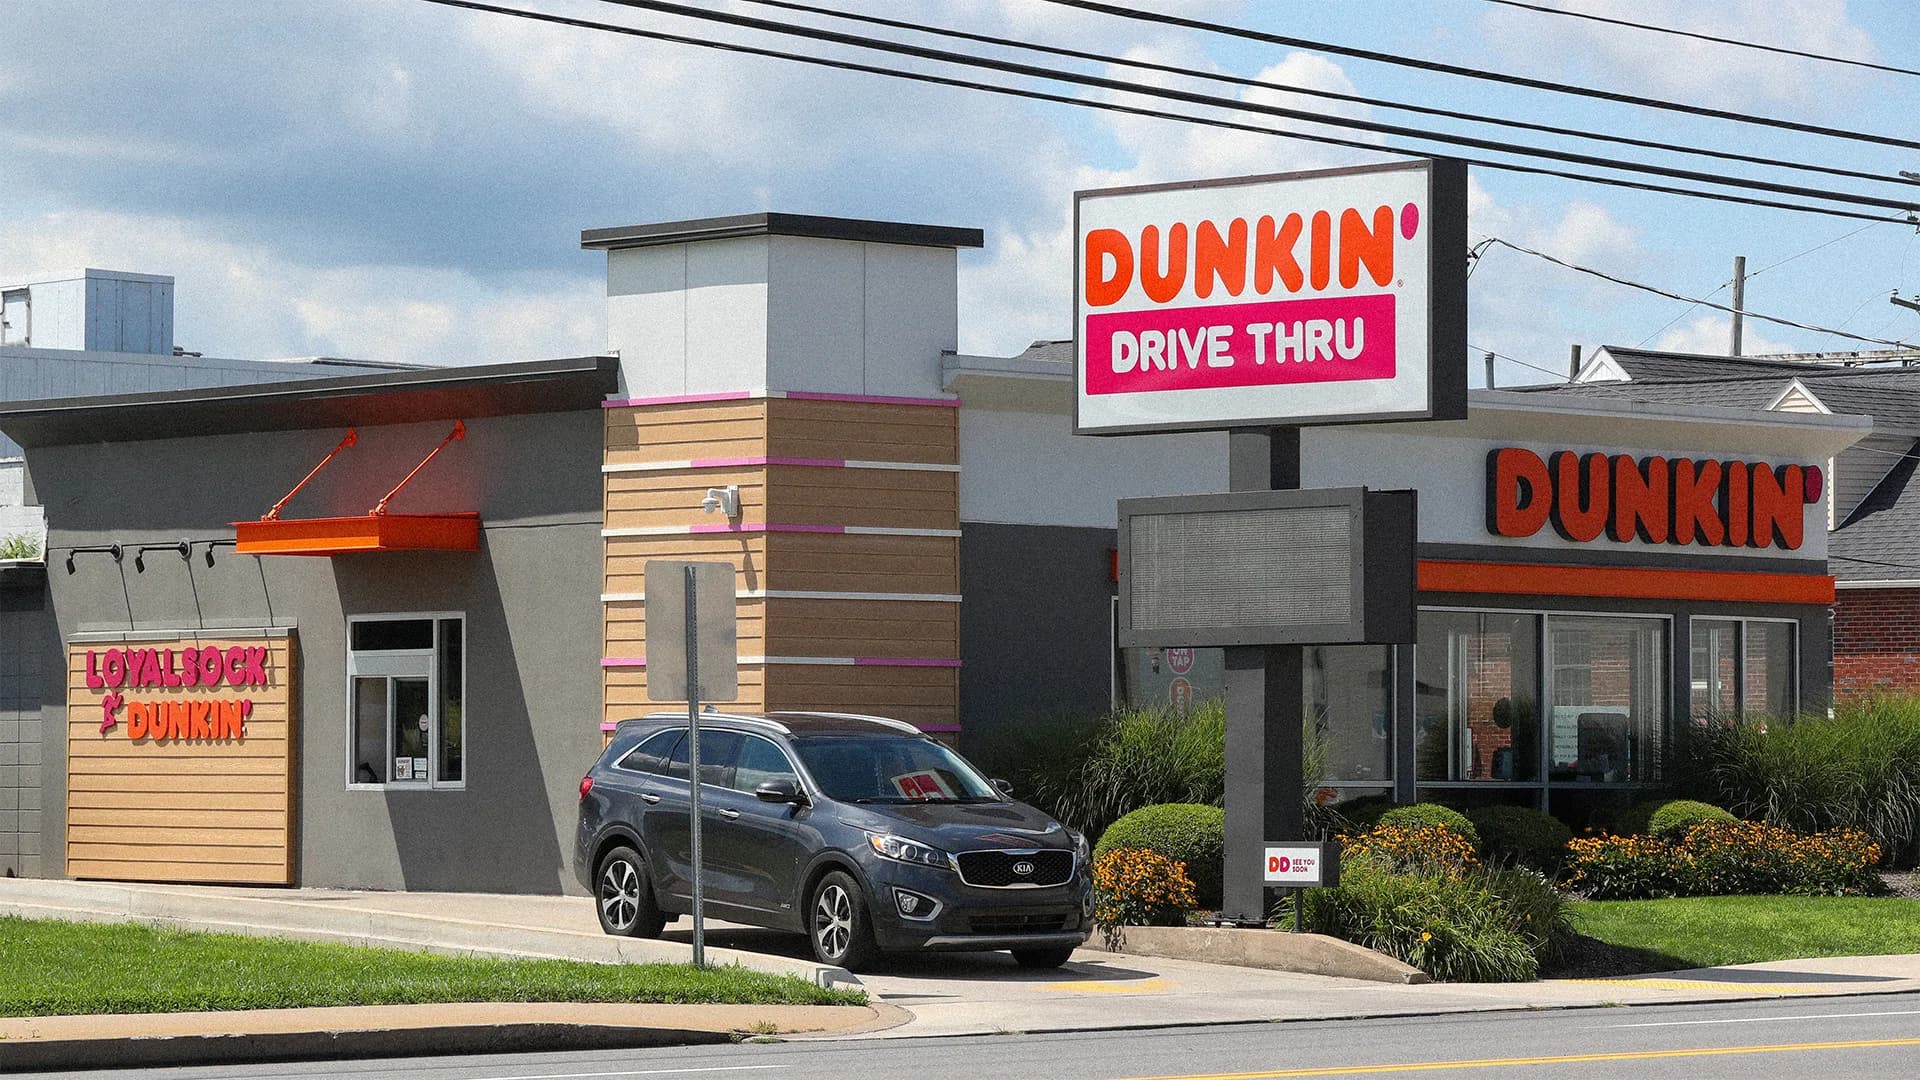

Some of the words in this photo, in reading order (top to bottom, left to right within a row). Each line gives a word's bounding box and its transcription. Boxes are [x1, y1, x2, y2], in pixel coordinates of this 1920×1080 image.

[1085, 202, 1420, 307] DUNKIN'
[1111, 325, 1235, 374] DRIVE
[1246, 316, 1365, 366] THRU
[1487, 447, 1823, 550] DUNKIN'
[86, 645, 268, 689] LOYALSOCK
[1171, 655, 1190, 667] TAP
[127, 699, 253, 740] DUNKIN'
[1016, 864, 1032, 873] KIA
[1269, 856, 1291, 873] DD
[1292, 858, 1303, 866] SEE
[1303, 858, 1316, 866] YOU
